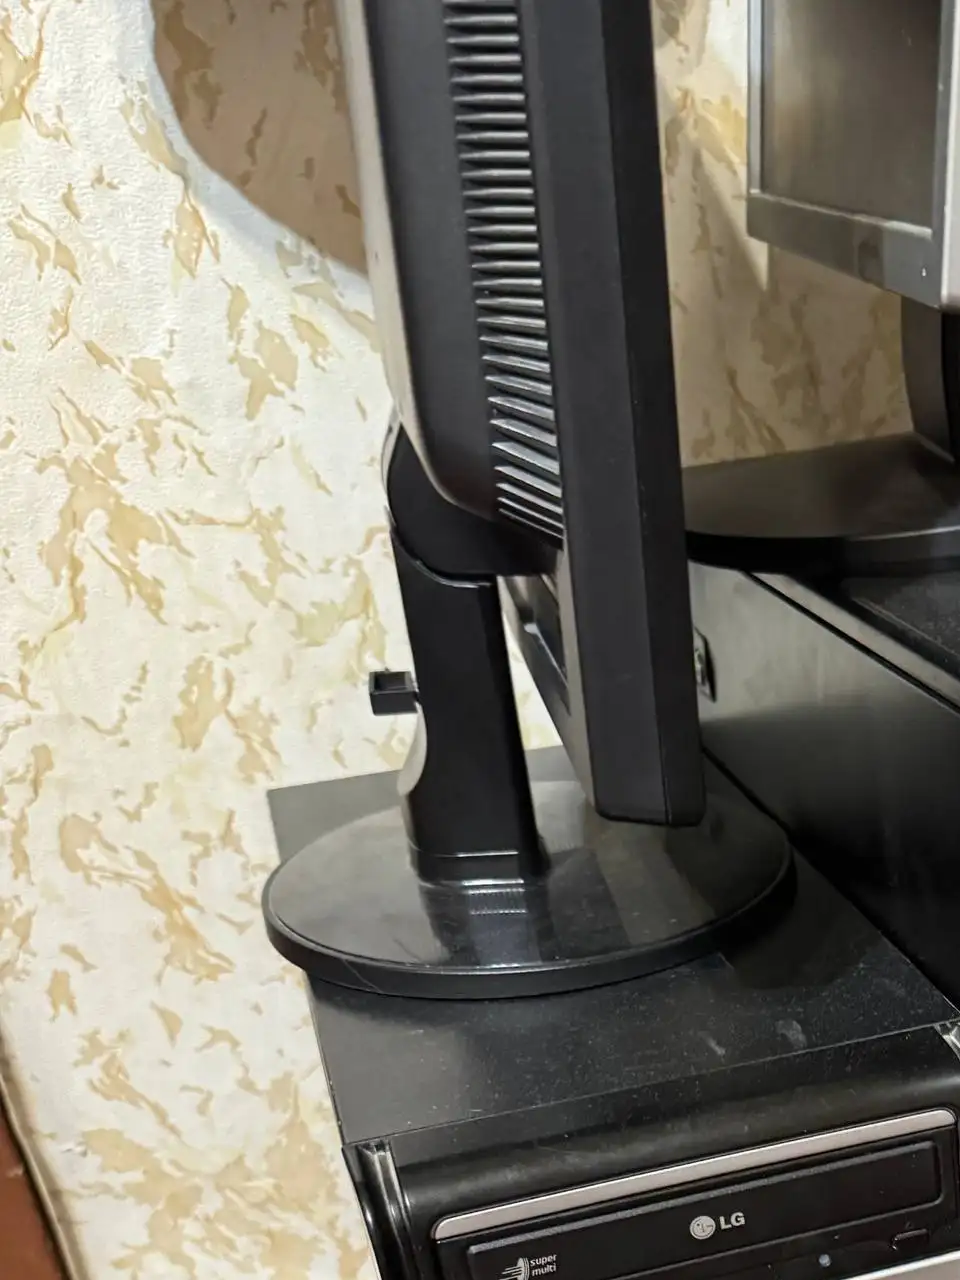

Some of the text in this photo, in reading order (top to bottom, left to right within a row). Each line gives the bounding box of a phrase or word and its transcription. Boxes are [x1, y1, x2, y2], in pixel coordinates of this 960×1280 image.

[719, 1211, 746, 1230] LG
[530, 1254, 557, 1267] super
[532, 1262, 557, 1277] multi
